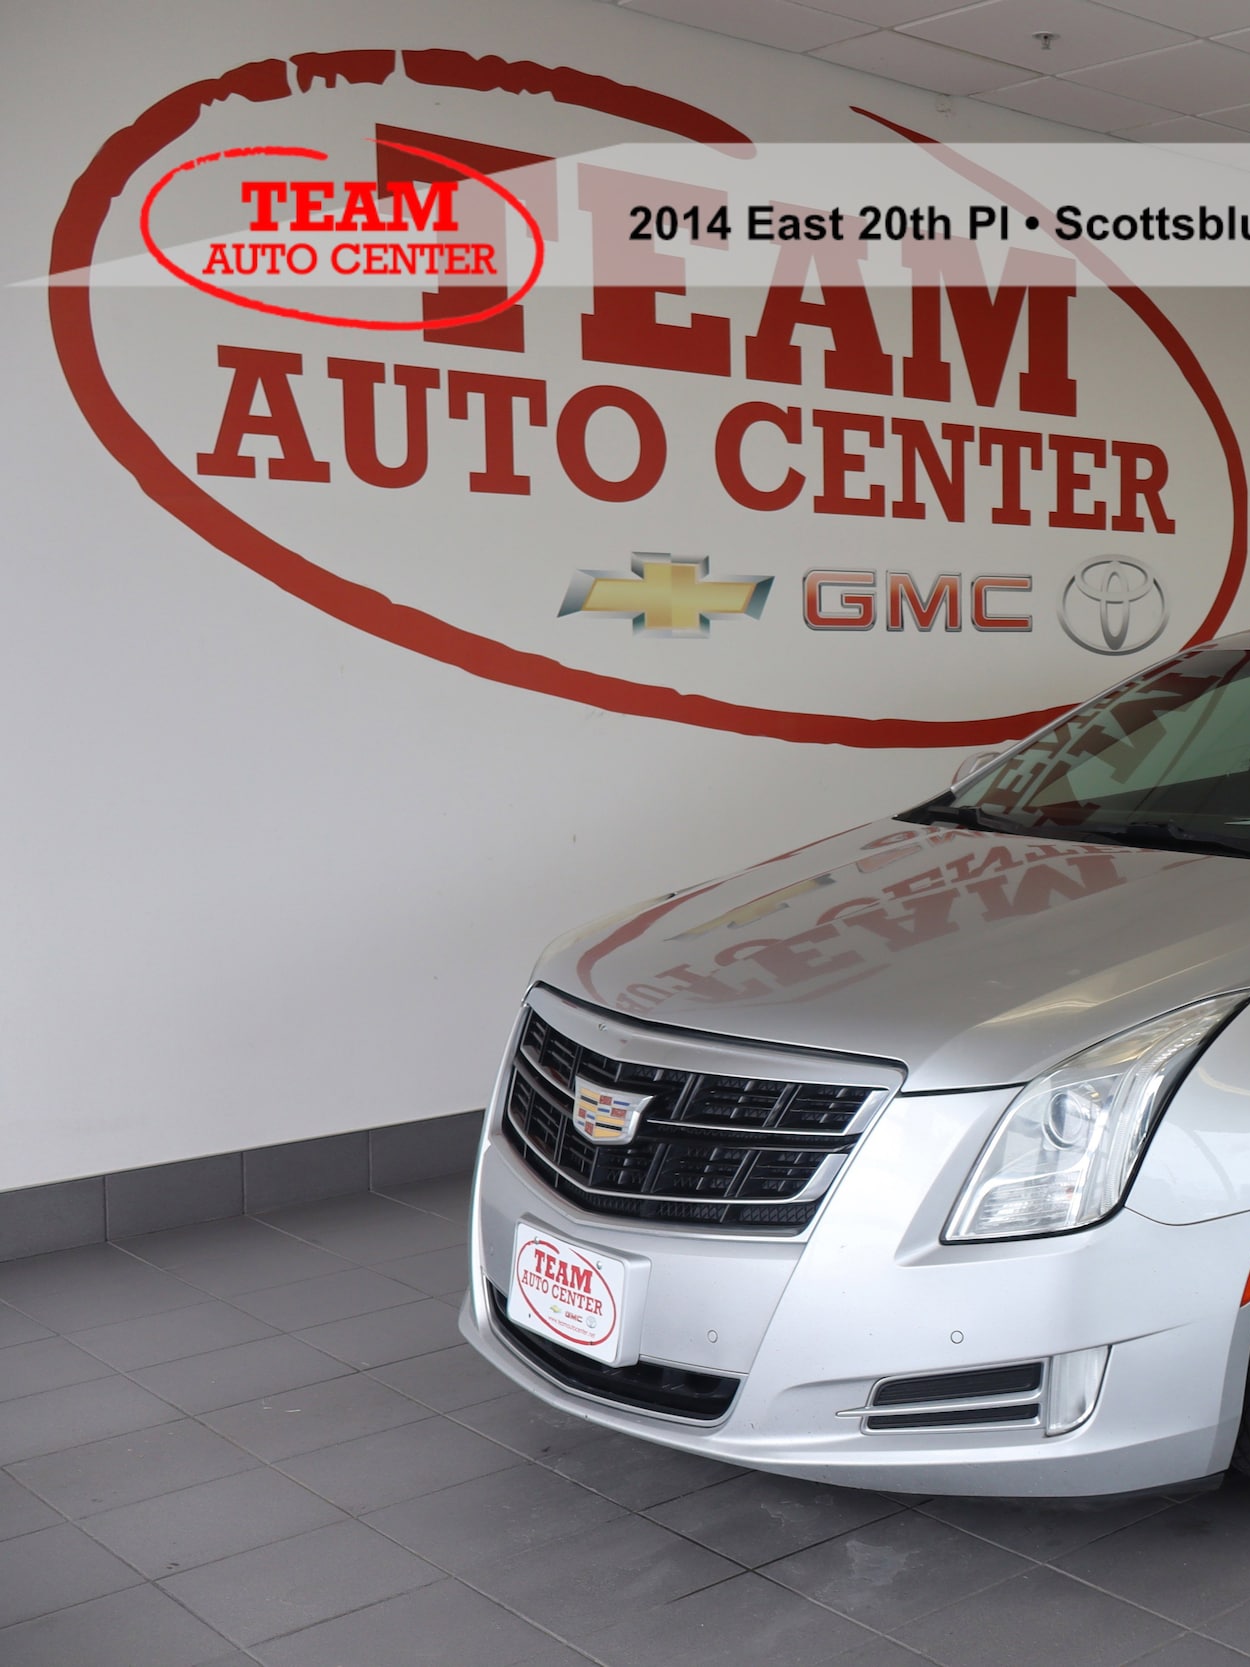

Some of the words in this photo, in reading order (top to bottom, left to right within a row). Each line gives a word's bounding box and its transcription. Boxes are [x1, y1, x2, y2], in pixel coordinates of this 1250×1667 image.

[375, 122, 1078, 418] TEAM
[196, 343, 668, 504] AUTO
[713, 400, 1176, 535] CENTER
[802, 569, 1032, 632] GMC
[522, 1269, 549, 1293] AUTO
[552, 1285, 602, 1316] CENTER
[535, 1248, 592, 1294] TEAM
